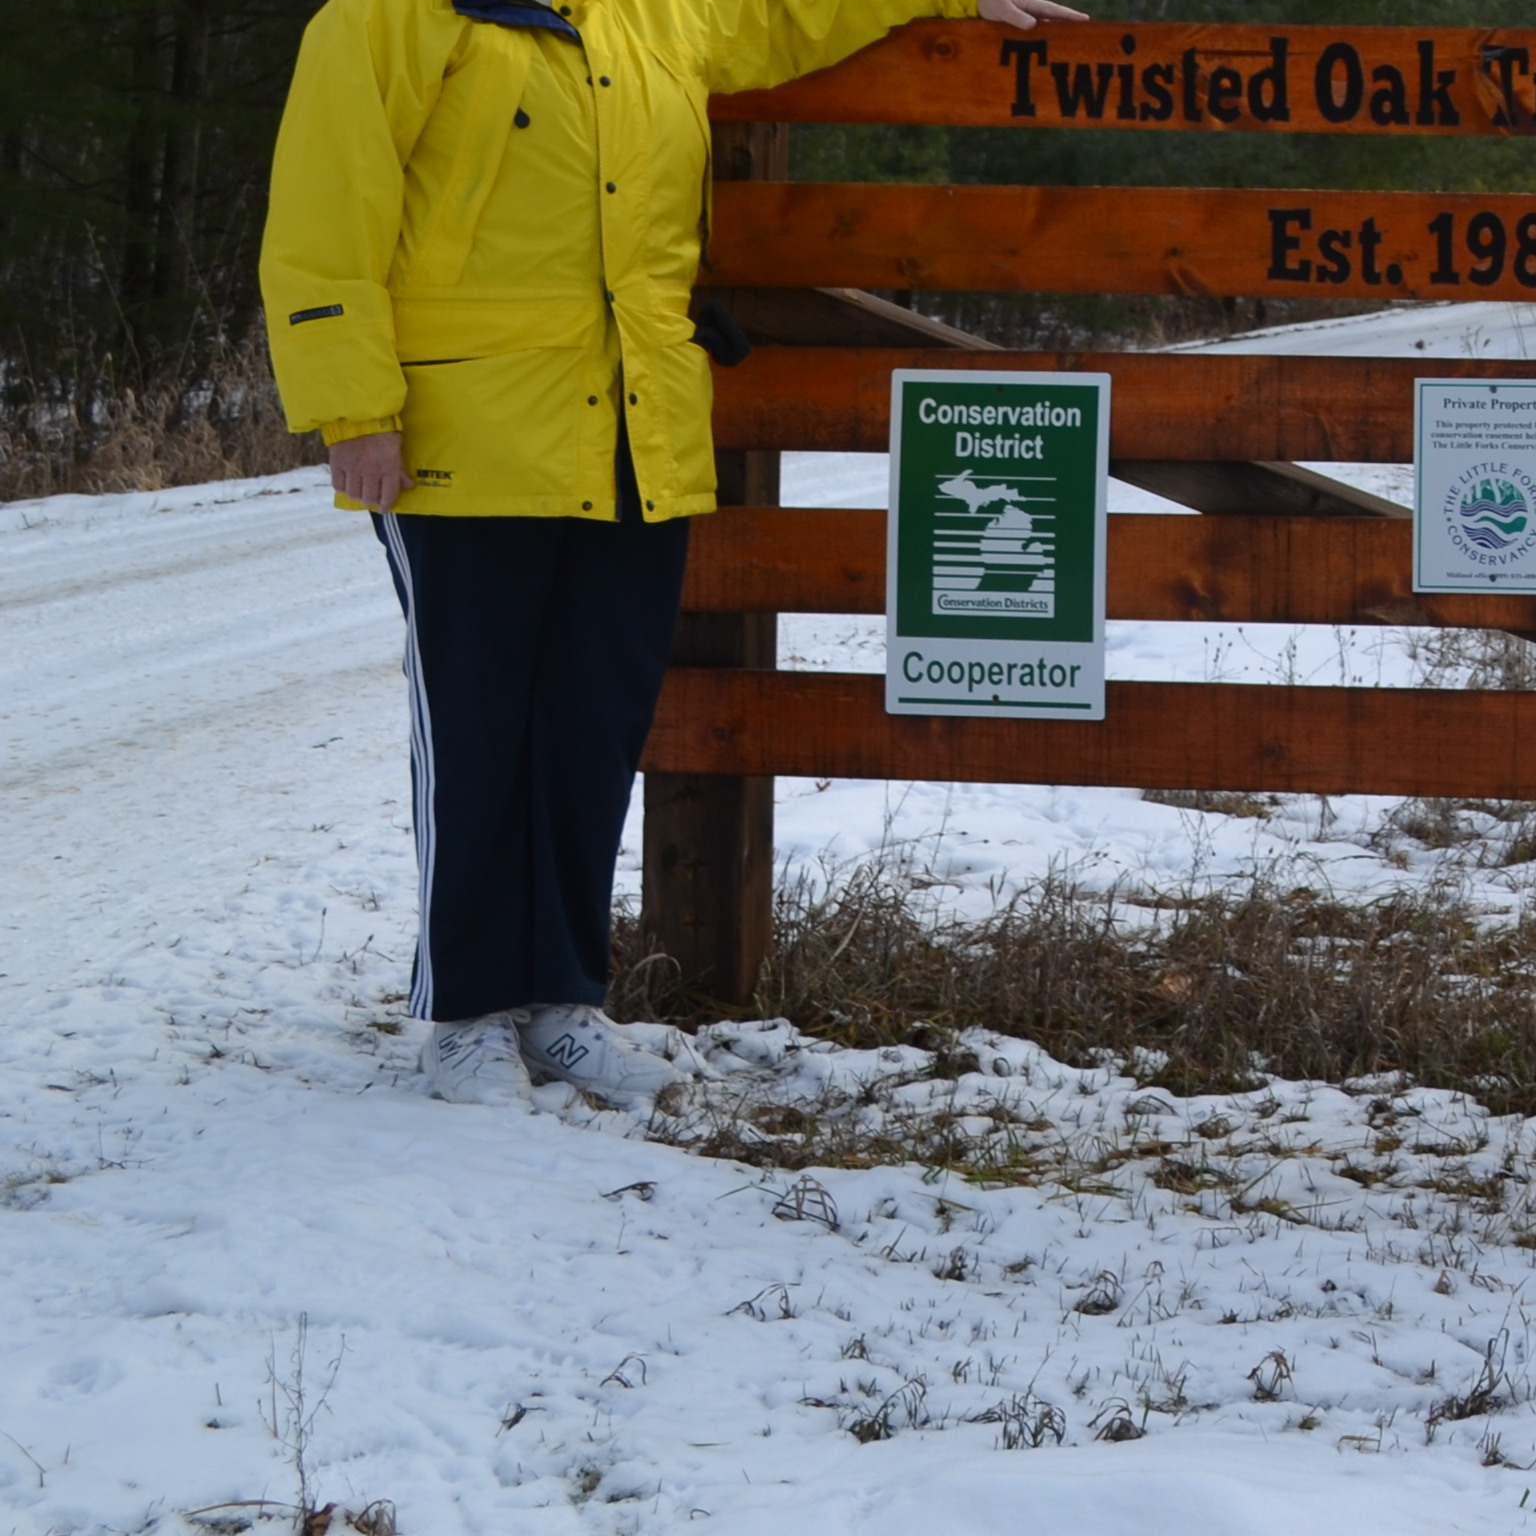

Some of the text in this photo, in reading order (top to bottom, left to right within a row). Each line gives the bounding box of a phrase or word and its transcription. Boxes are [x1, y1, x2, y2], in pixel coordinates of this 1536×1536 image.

[1000, 33, 1290, 123] Twisted
[1315, 40, 1461, 127] Oak
[1266, 207, 1403, 286] Est.
[918, 397, 1082, 427] Conservation
[1443, 398, 1487, 410] Private
[1430, 431, 1482, 439] conservation
[1485, 432, 1523, 440] easement
[1435, 420, 1453, 429] This
[1455, 421, 1491, 431] property
[1493, 421, 1532, 431] protected
[955, 431, 1044, 460] District
[1433, 441, 1448, 450] The
[1450, 441, 1472, 450] Little
[1476, 441, 1499, 450] Forks
[1444, 485, 1460, 514] THE
[1459, 462, 1508, 484] LITTLE
[938, 594, 1048, 610] Conservation Districts
[902, 651, 1082, 693] Cooperator
